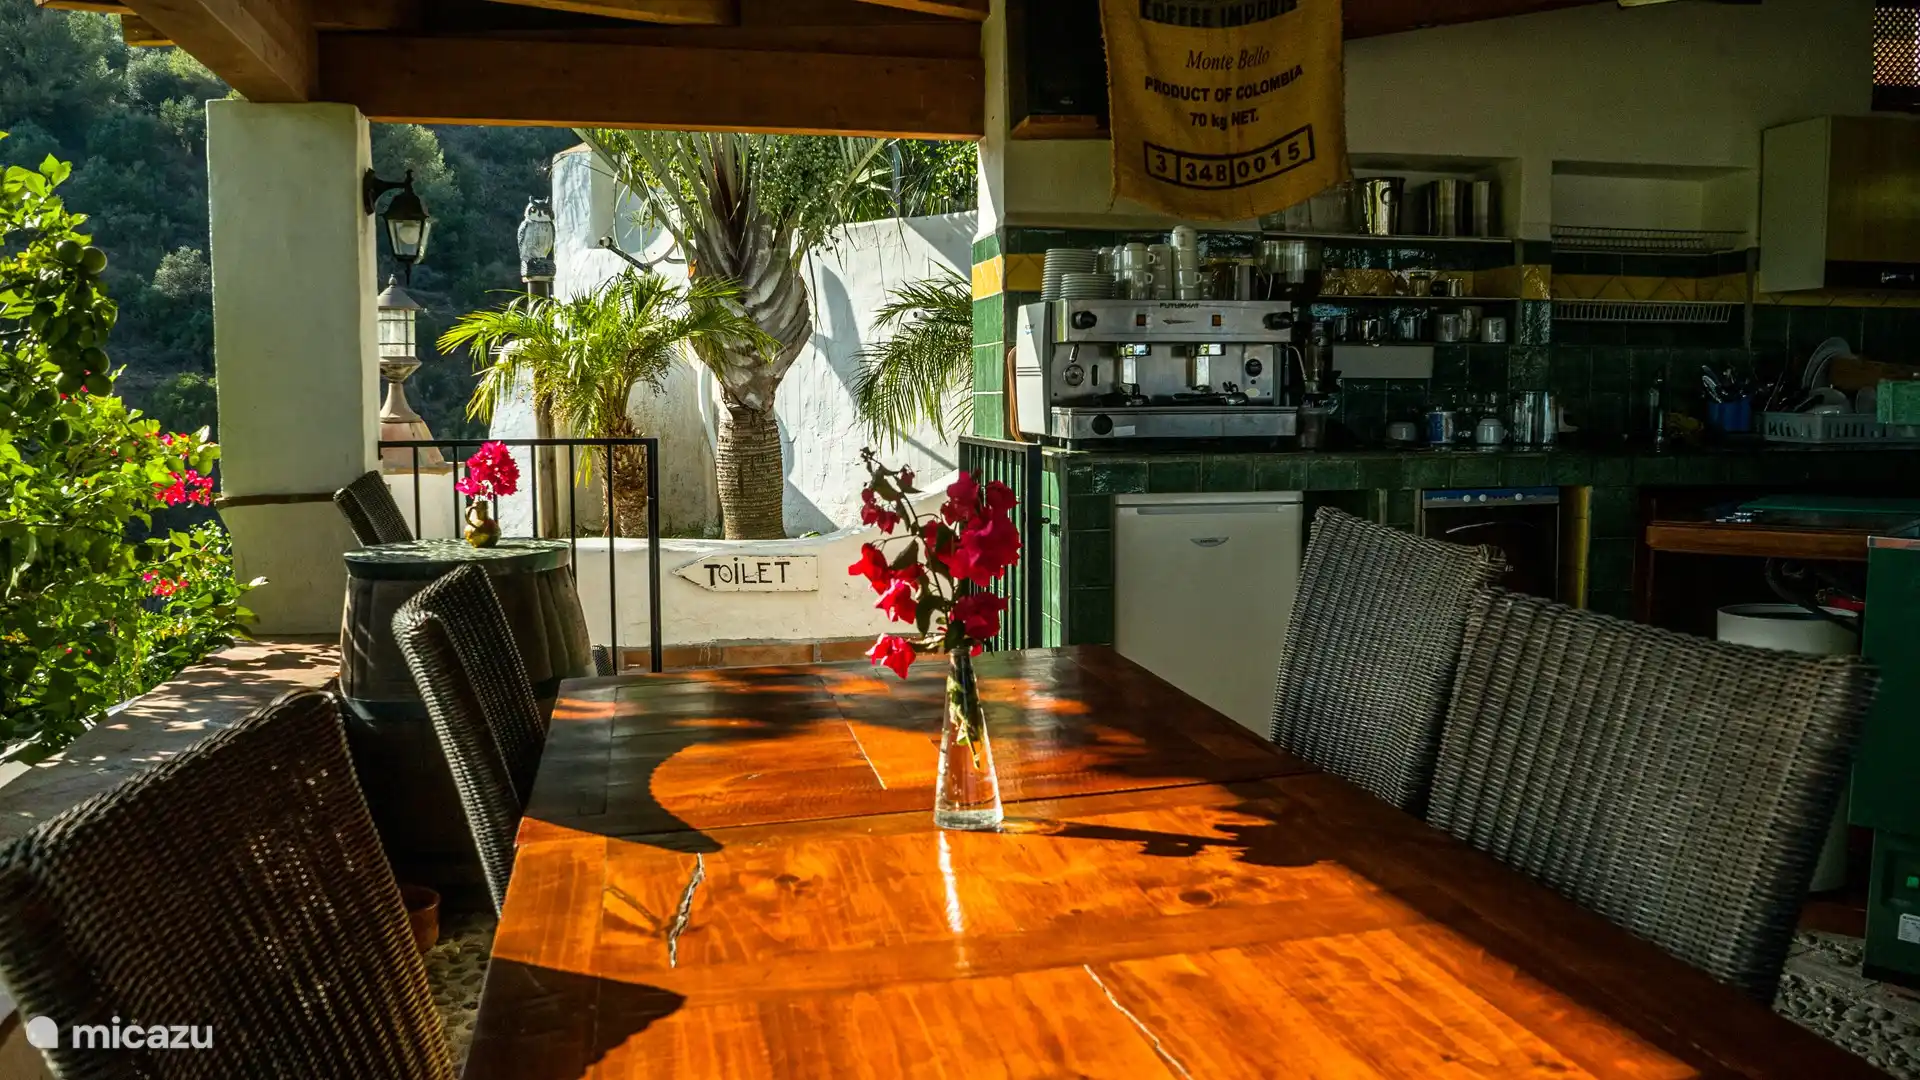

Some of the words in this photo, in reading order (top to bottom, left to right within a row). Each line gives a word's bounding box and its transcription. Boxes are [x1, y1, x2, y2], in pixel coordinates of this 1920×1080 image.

[1185, 49, 1234, 71] Monte
[1238, 46, 1270, 70] Bello
[1145, 75, 1210, 102] PRODUCT
[1214, 87, 1232, 102] OF
[1236, 64, 1303, 101] COLOMBIA
[1190, 112, 1207, 127] 70
[1211, 115, 1228, 130] kg
[1231, 109, 1260, 126] NET.
[1155, 153, 1168, 173] 3
